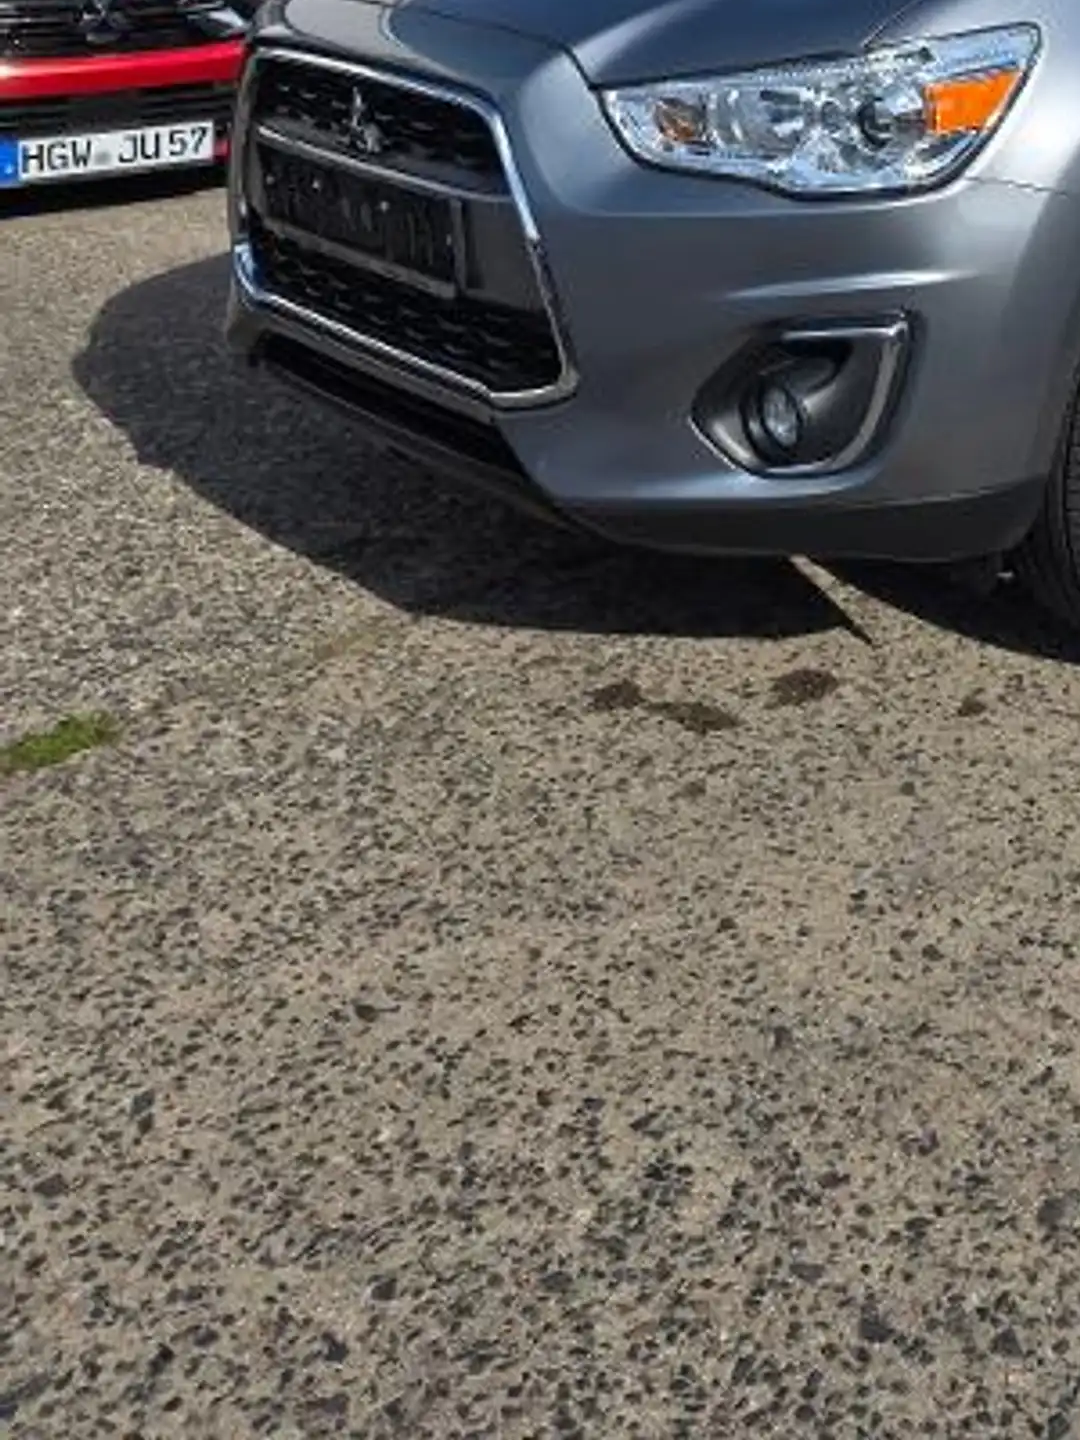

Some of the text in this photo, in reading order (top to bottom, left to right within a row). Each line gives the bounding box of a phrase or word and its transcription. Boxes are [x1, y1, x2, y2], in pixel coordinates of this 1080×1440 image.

[22, 125, 209, 173] HGW JU 57
